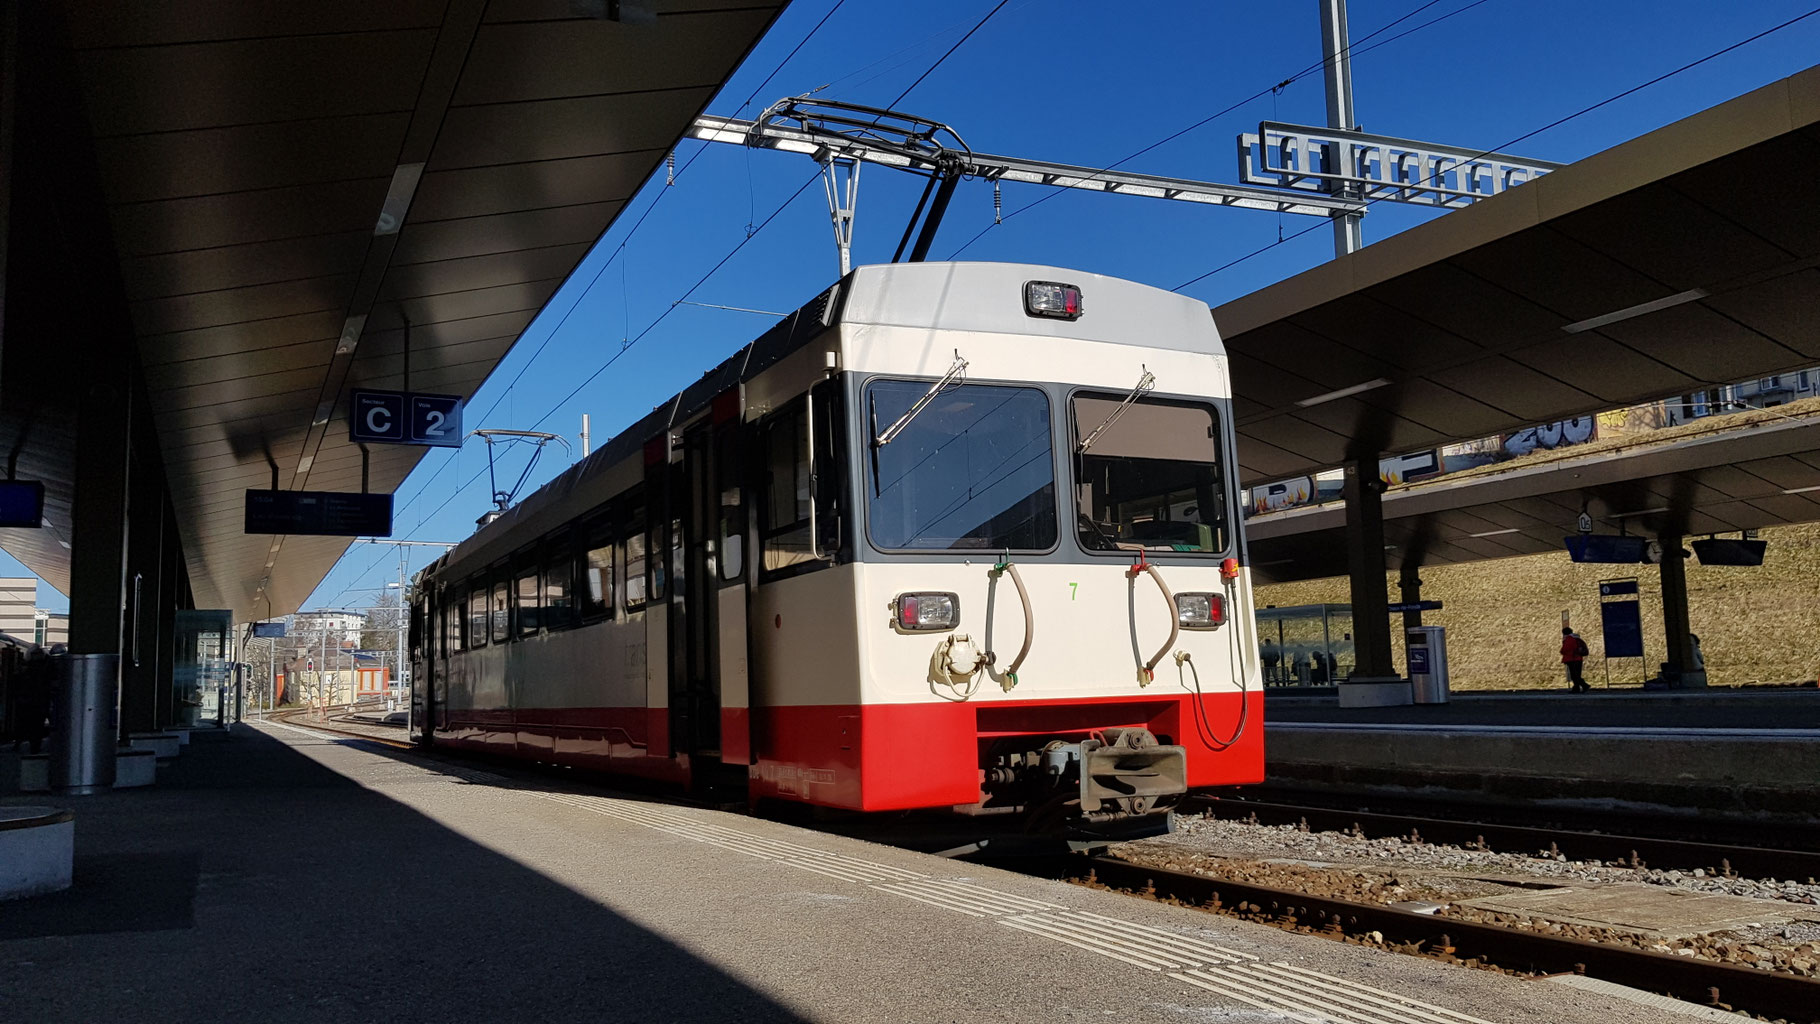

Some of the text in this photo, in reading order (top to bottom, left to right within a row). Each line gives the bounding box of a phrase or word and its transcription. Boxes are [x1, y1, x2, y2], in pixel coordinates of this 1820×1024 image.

[367, 407, 392, 433] C
[425, 410, 445, 436] 2
[1069, 582, 1078, 601] 7
